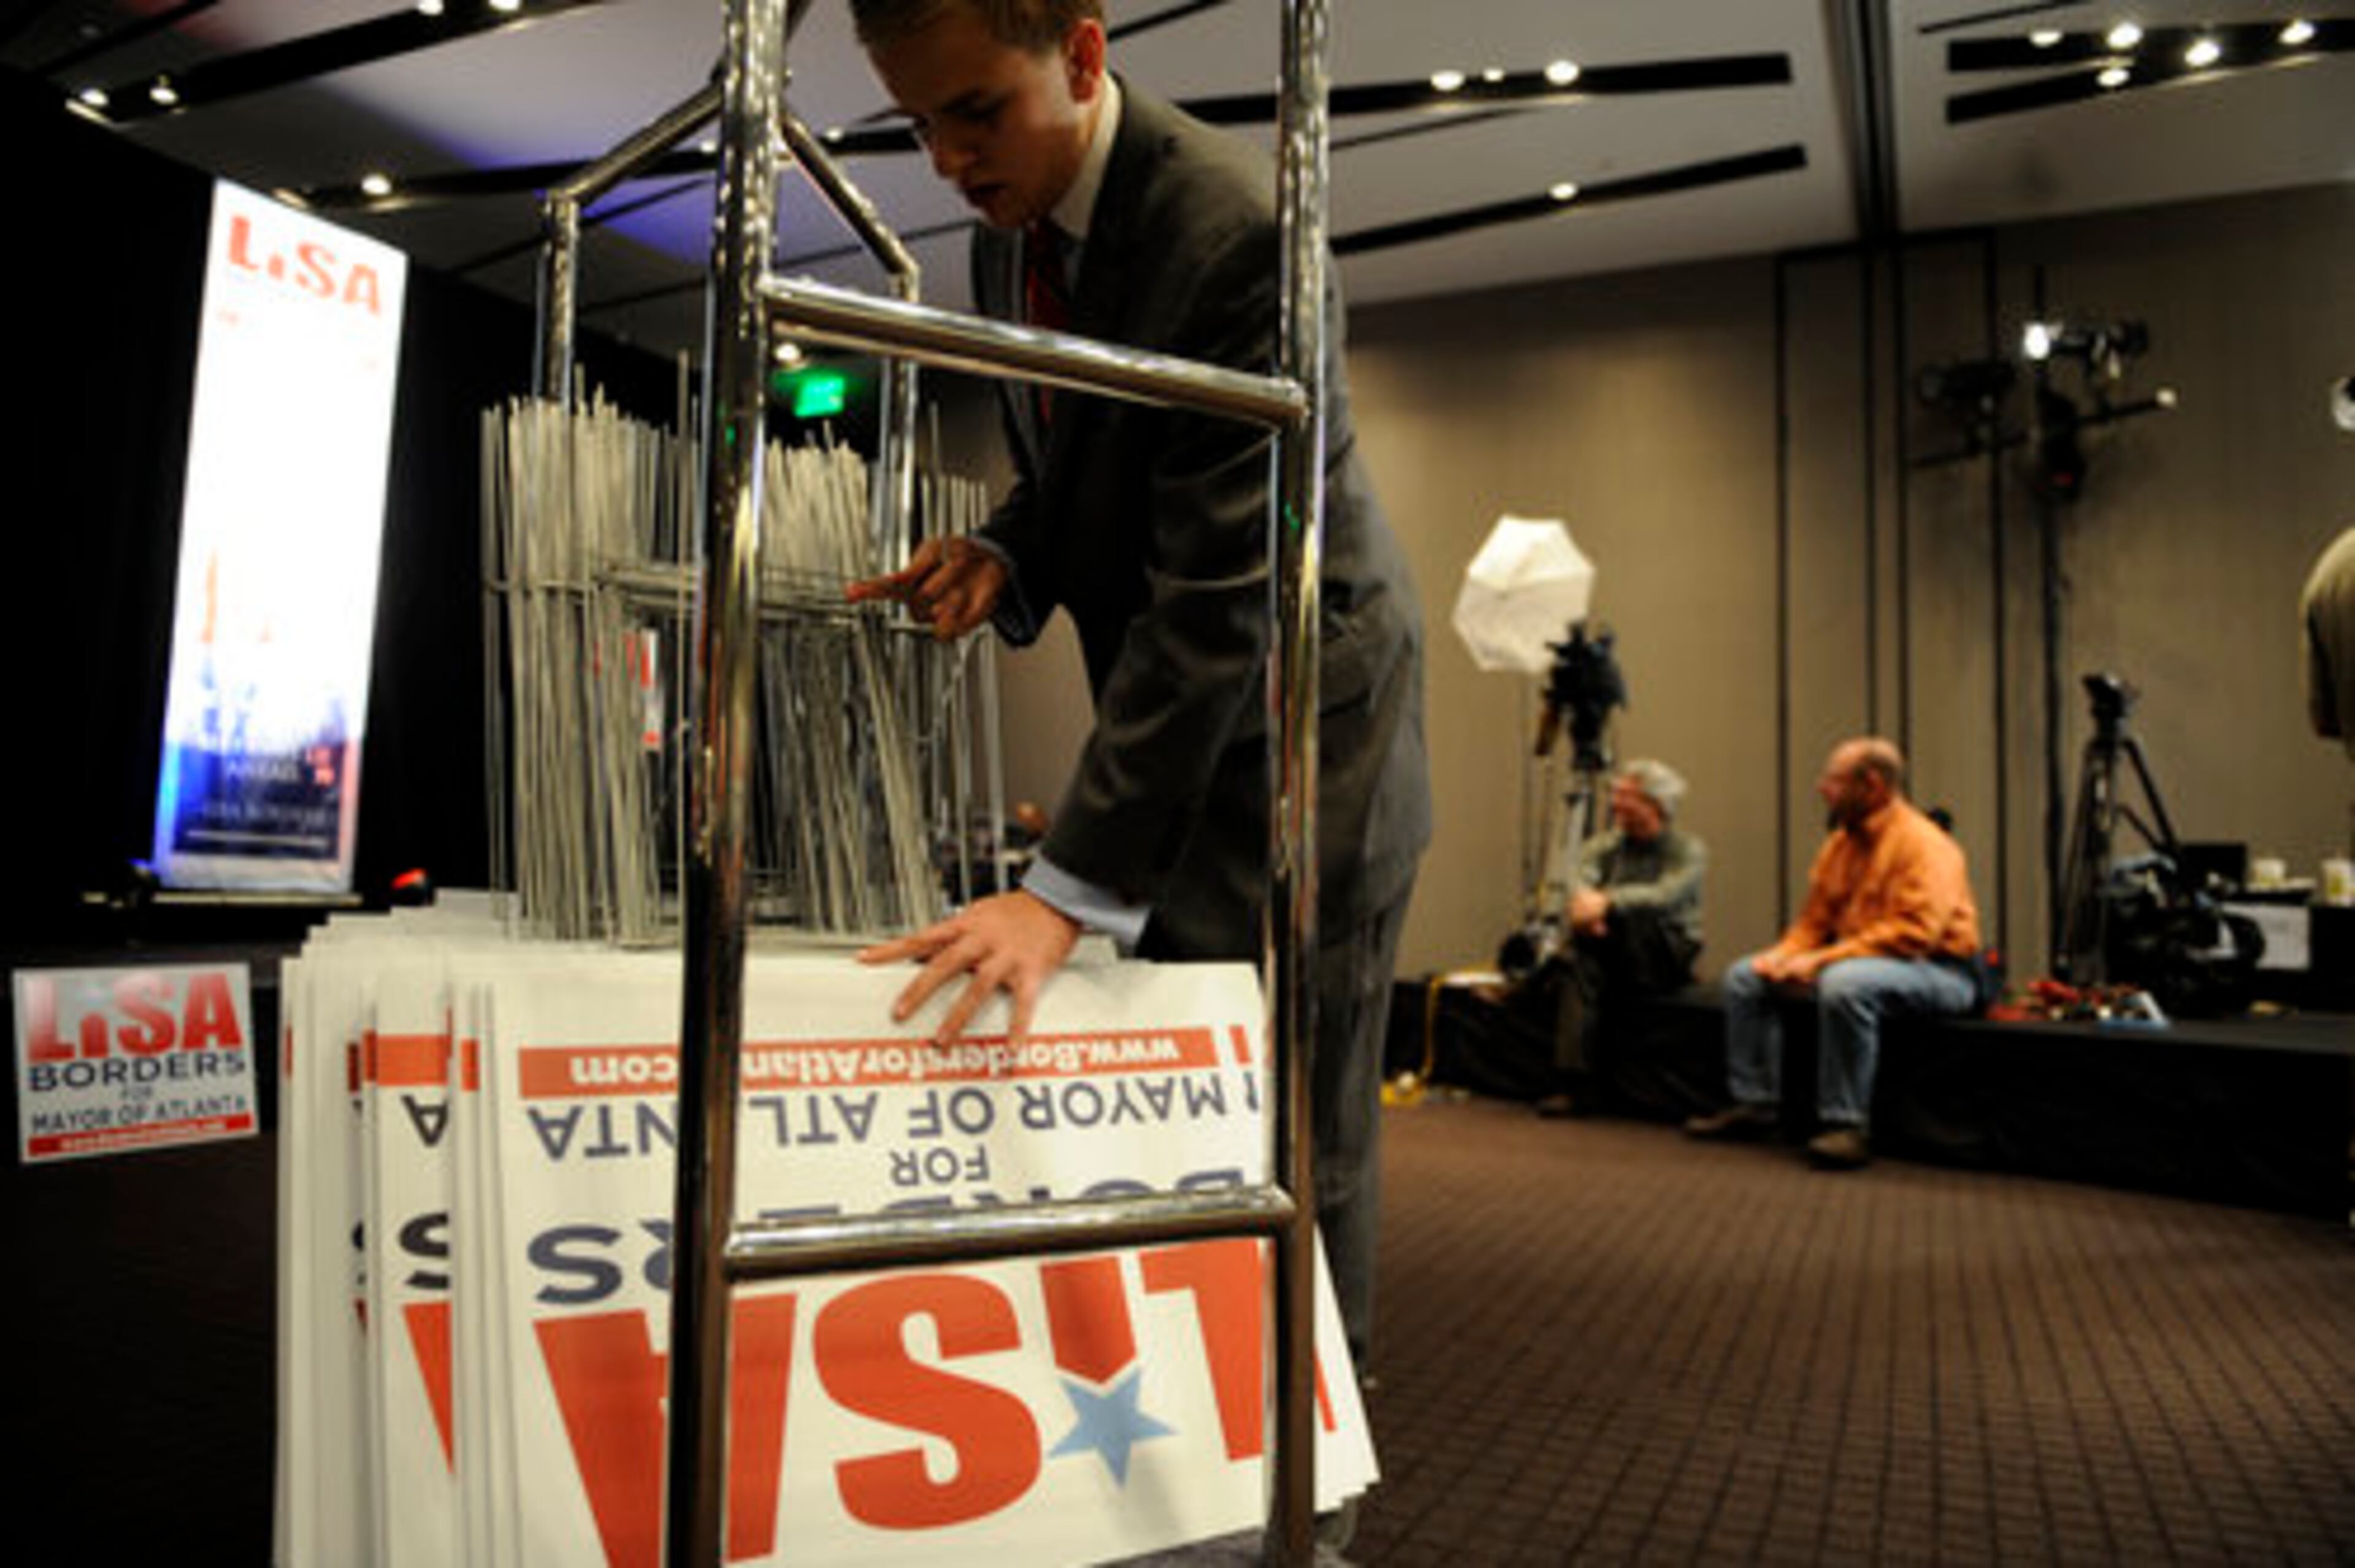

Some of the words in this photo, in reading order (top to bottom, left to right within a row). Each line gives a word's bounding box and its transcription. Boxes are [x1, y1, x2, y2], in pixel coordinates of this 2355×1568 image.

[29, 1052, 245, 1092] BORDERS
[569, 1037, 1181, 1084] www.BordersforAtlancom
[31, 1106, 111, 1133] MAYOR
[155, 1095, 246, 1119] ATLANTA
[908, 1087, 995, 1139] OF
[1016, 1074, 1228, 1130] MAYOR
[527, 1092, 878, 1160] ATLNTA
[890, 1144, 990, 1187] FOR
